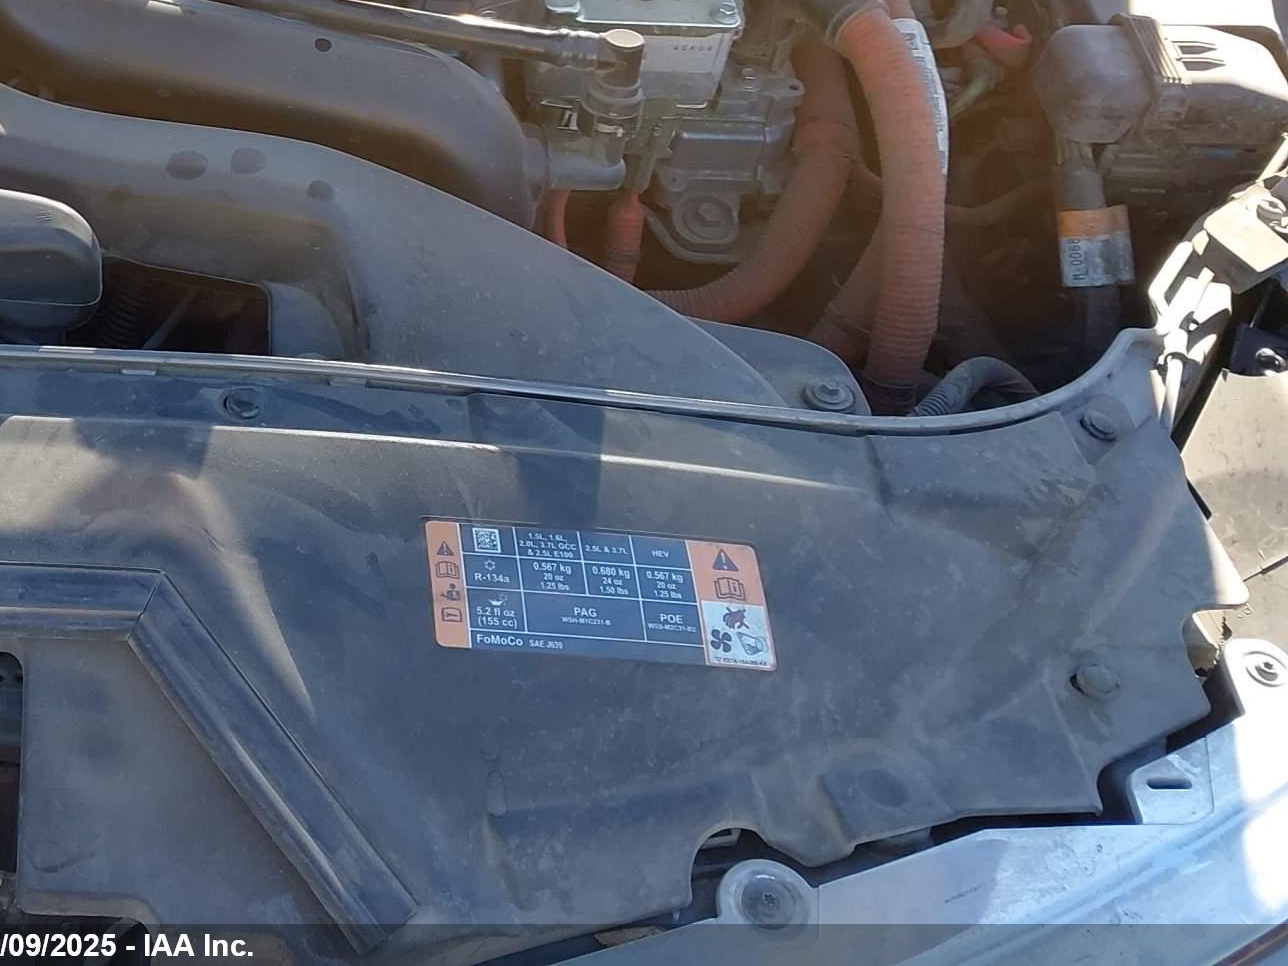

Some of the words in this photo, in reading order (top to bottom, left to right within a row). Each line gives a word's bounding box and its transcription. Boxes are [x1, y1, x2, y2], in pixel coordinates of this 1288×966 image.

[558, 543, 577, 551] GCC
[604, 545, 611, 553] &
[651, 550, 670, 558] HEV
[533, 561, 558, 572] 0.567
[559, 563, 572, 575] kg
[592, 566, 617, 576] 0.680
[618, 568, 631, 579] kg
[474, 572, 510, 583] R-134a
[543, 572, 553, 580] 20
[646, 571, 669, 581] 0.567
[671, 573, 684, 584] kg
[602, 577, 612, 585] 24
[656, 581, 666, 589] 20
[540, 582, 557, 590] 1.25
[557, 582, 571, 591] lbs
[600, 586, 616, 594] 1.50
[616, 586, 629, 595] lbs
[653, 590, 669, 598] 1.25
[670, 591, 683, 599] lbs
[476, 606, 492, 616] 5.2
[493, 607, 501, 616] fl
[503, 609, 516, 617] oz
[573, 607, 597, 618] PAG
[660, 613, 684, 624] POE
[477, 617, 500, 627] (155
[501, 618, 518, 630] cc)
[476, 634, 524, 647] FoMoCo
[528, 639, 545, 648] SAE
